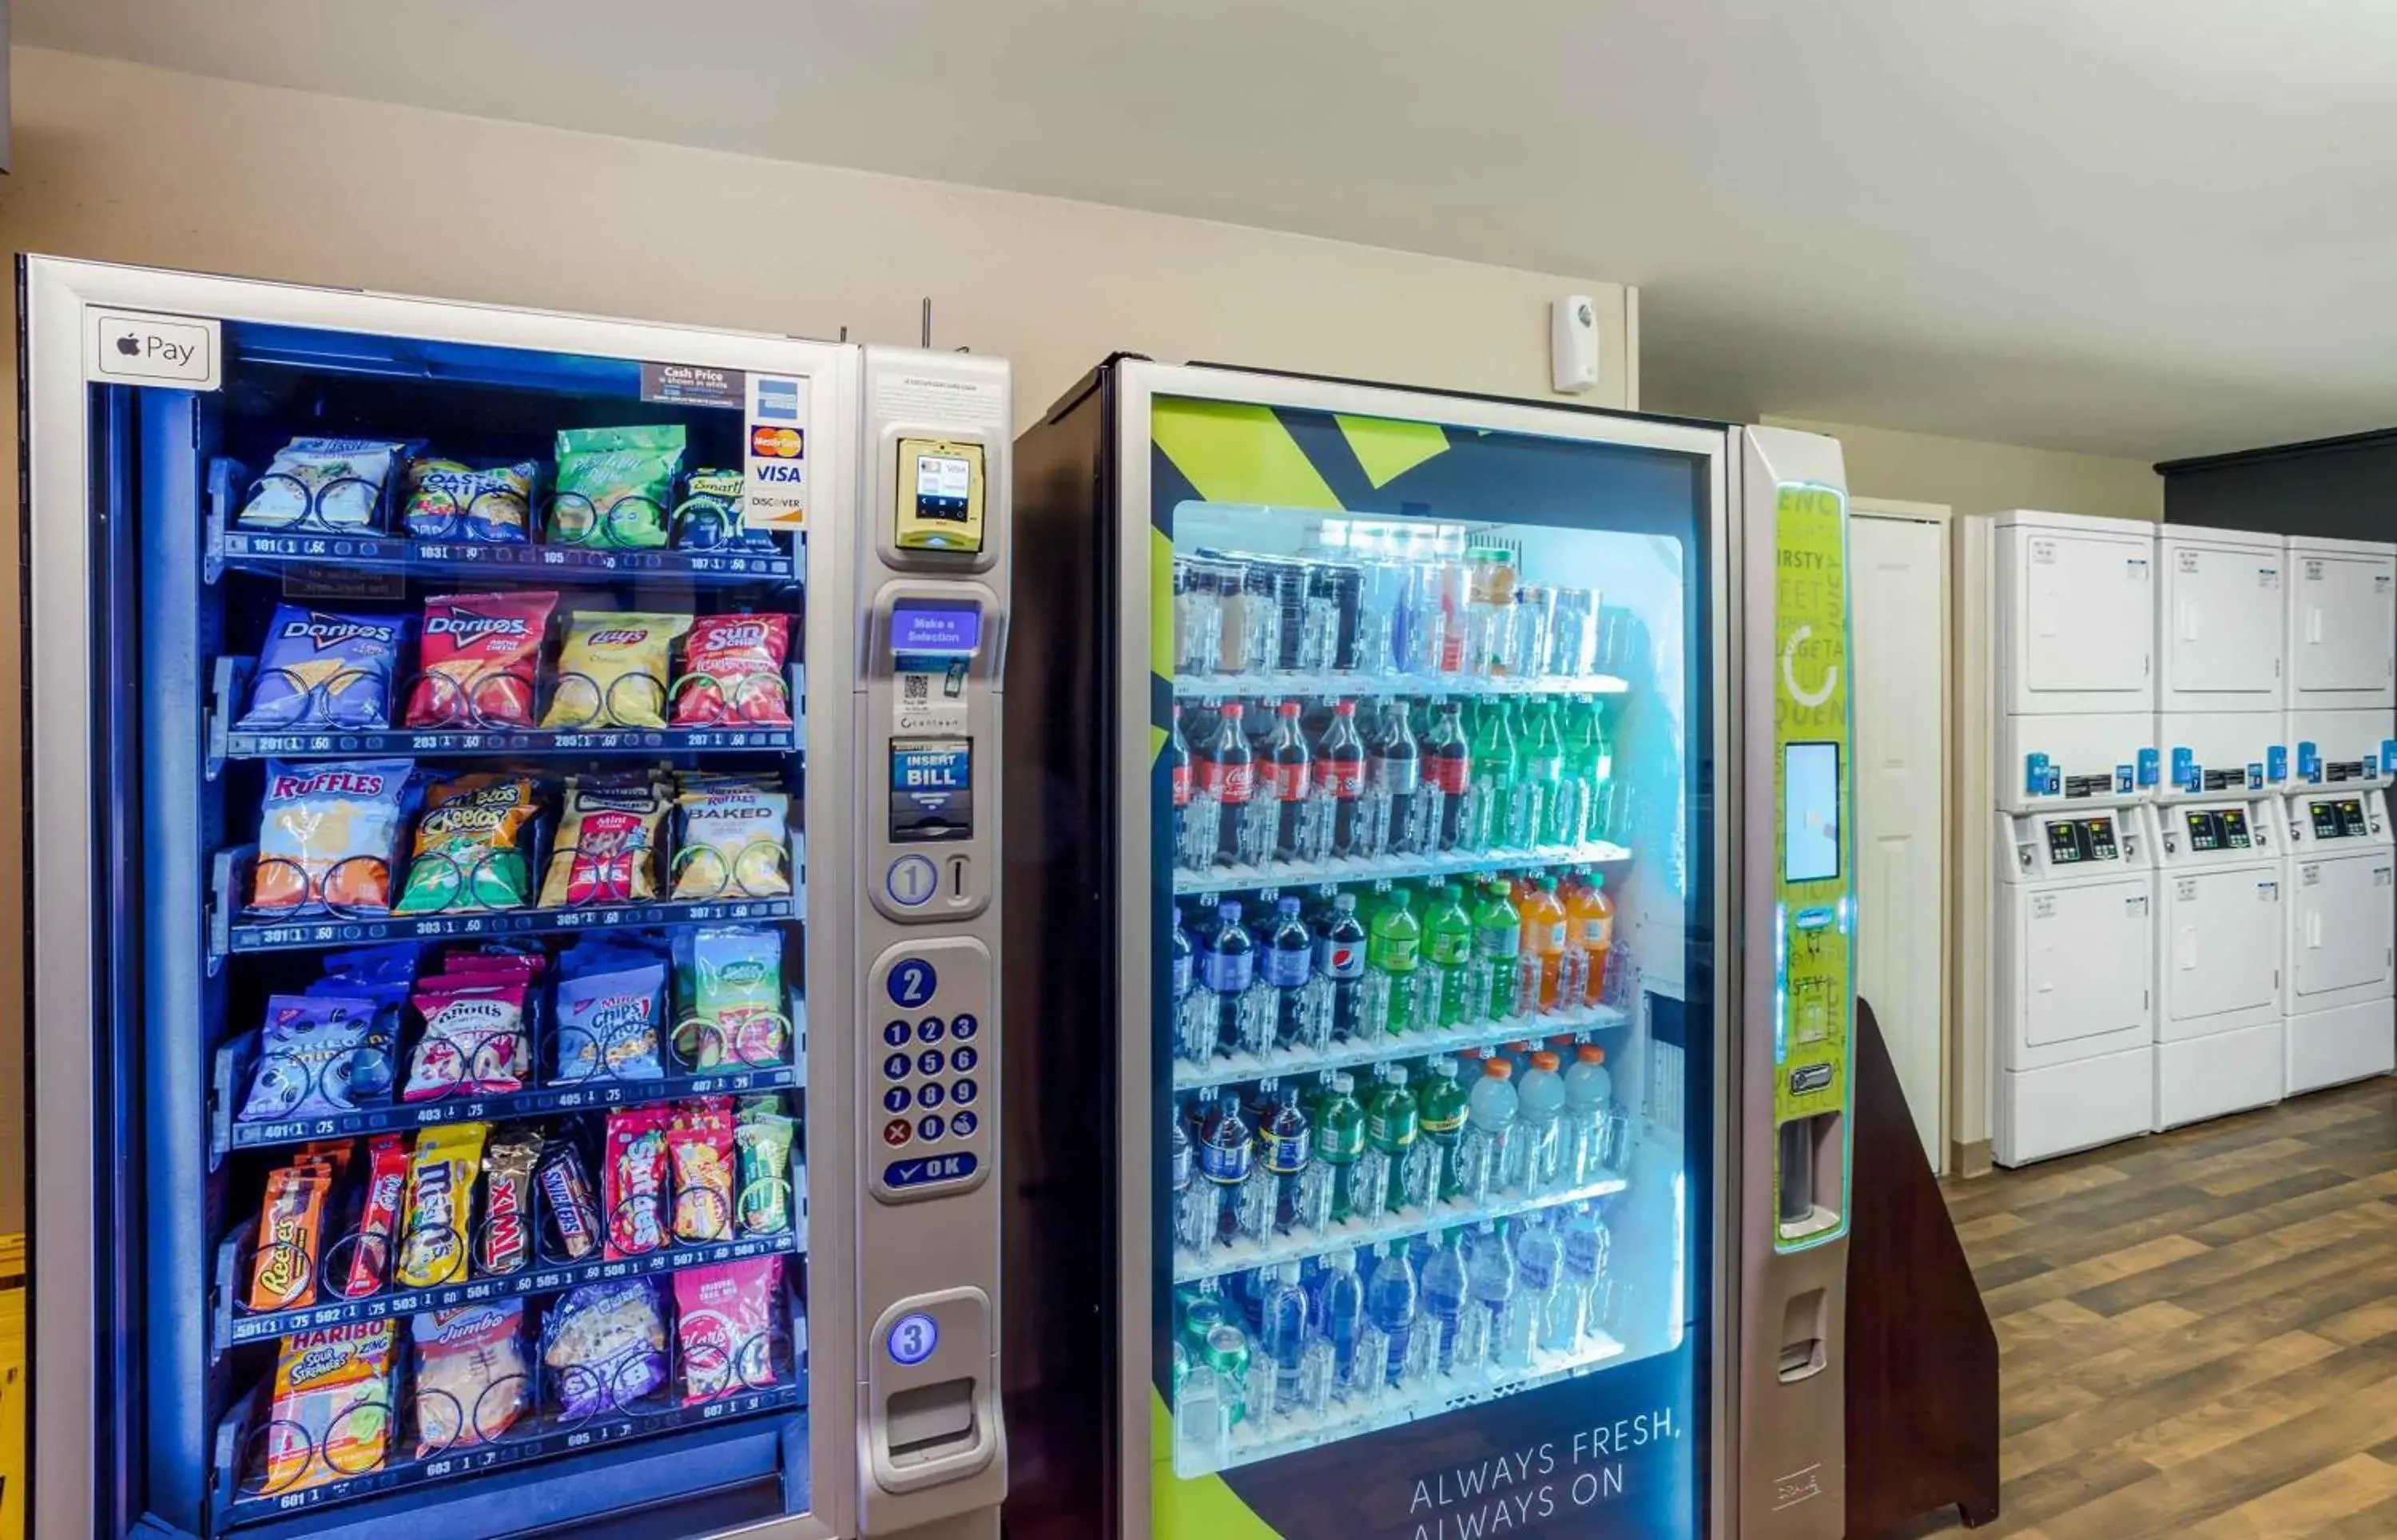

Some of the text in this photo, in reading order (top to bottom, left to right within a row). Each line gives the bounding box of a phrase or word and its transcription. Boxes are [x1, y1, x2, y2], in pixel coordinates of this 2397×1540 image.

[147, 335, 194, 367] Pay
[664, 367, 723, 381] Cash Price
[757, 466, 801, 483] VISA
[284, 622, 394, 642] Doritos
[427, 617, 527, 634] Doritos
[913, 618, 944, 629] Make
[706, 625, 761, 651] Sun
[908, 630, 960, 642] Selection
[907, 755, 956, 766] INSERT
[273, 773, 384, 798] RUFFLES
[908, 769, 956, 785] BILL
[690, 808, 773, 820] BAKED
[904, 865, 916, 895] 1
[264, 930, 288, 943] 301
[417, 922, 440, 935] 303
[903, 968, 923, 1000] 2
[892, 1018, 970, 1043] 1 2 3
[891, 1050, 970, 1074] 4 5 6
[892, 1082, 970, 1108] 7 8 9
[418, 1107, 441, 1121] 403
[265, 1125, 289, 1140] 401
[925, 1119, 936, 1137] 0
[926, 1158, 960, 1177] OK
[487, 1177, 522, 1267] TWIX
[392, 1297, 417, 1310] 503
[292, 1320, 386, 1349] HARIBO
[439, 1312, 503, 1344] Jumbo
[904, 1324, 923, 1355] 3
[427, 1463, 451, 1476] 603
[1409, 1407, 1681, 1514] ALWAYS FRESH,
[1572, 1463, 1623, 1506] ON
